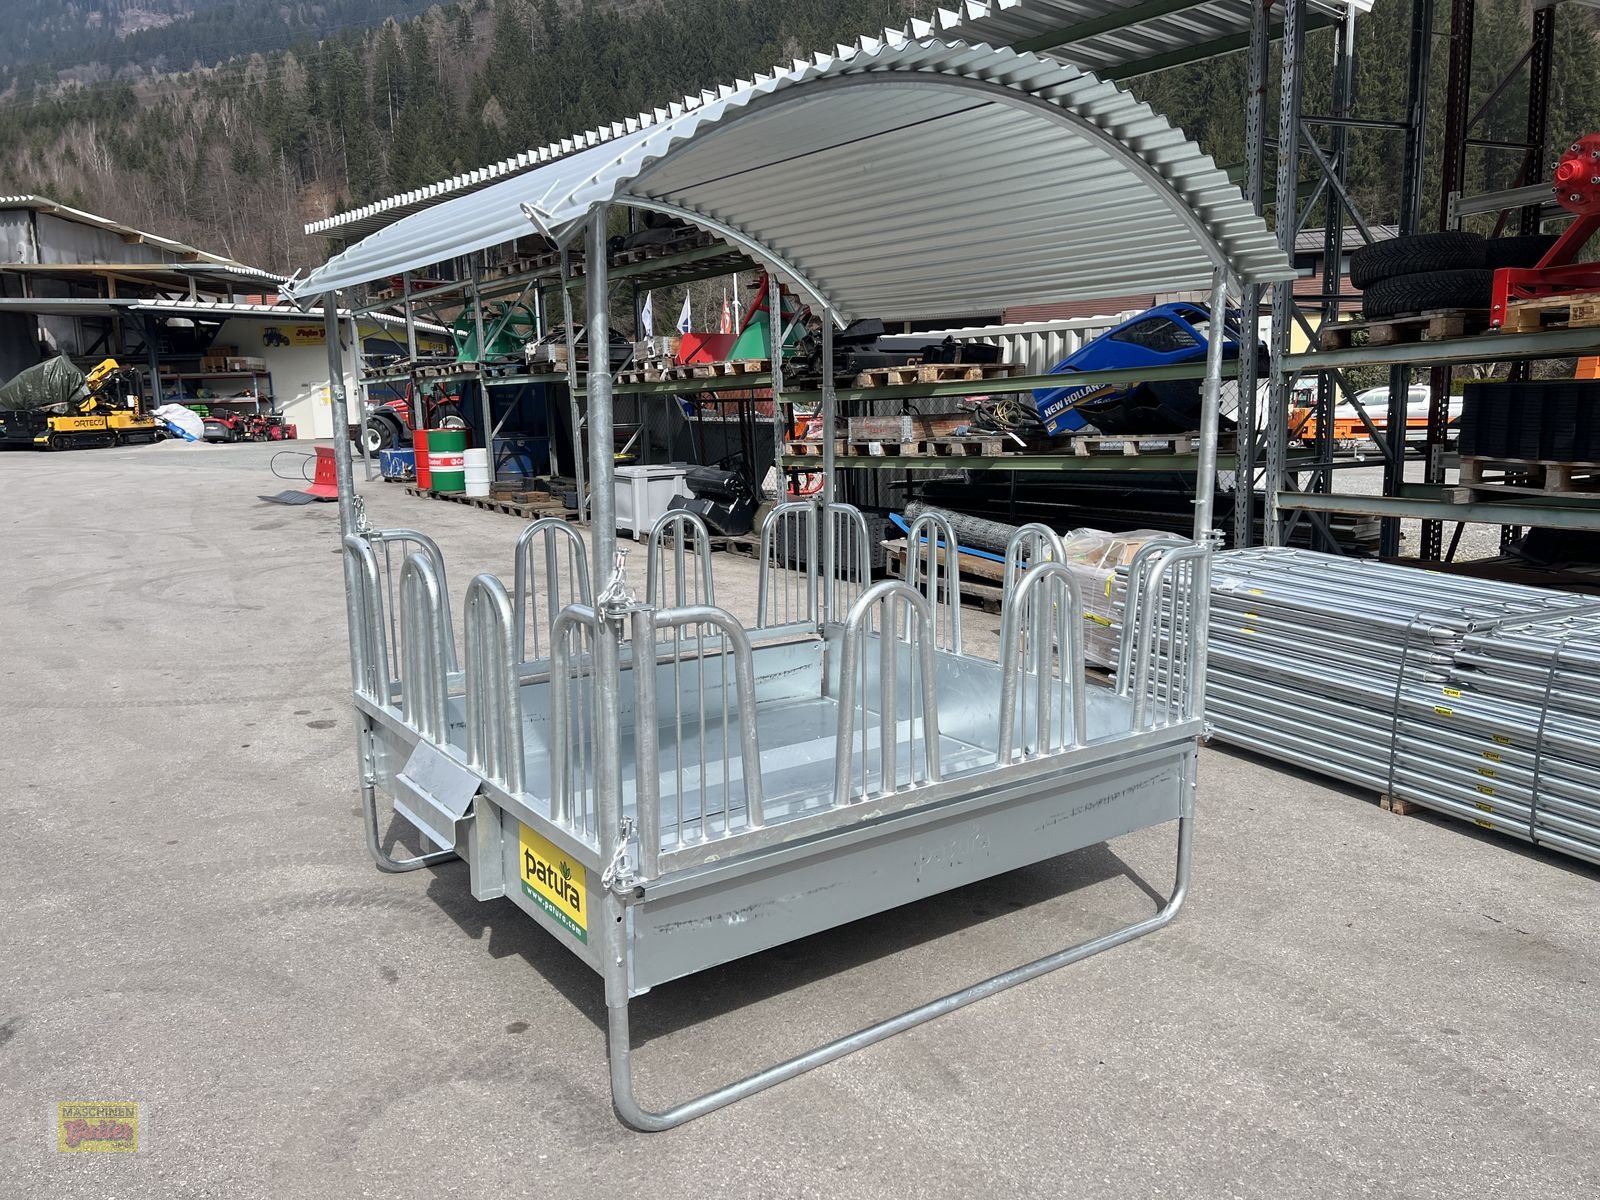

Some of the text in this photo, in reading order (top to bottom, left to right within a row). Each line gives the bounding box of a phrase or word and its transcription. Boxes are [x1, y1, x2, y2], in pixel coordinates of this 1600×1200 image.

[1044, 402, 1063, 417] NEW
[524, 848, 580, 912] patura
[527, 886, 581, 936] www.patura.com
